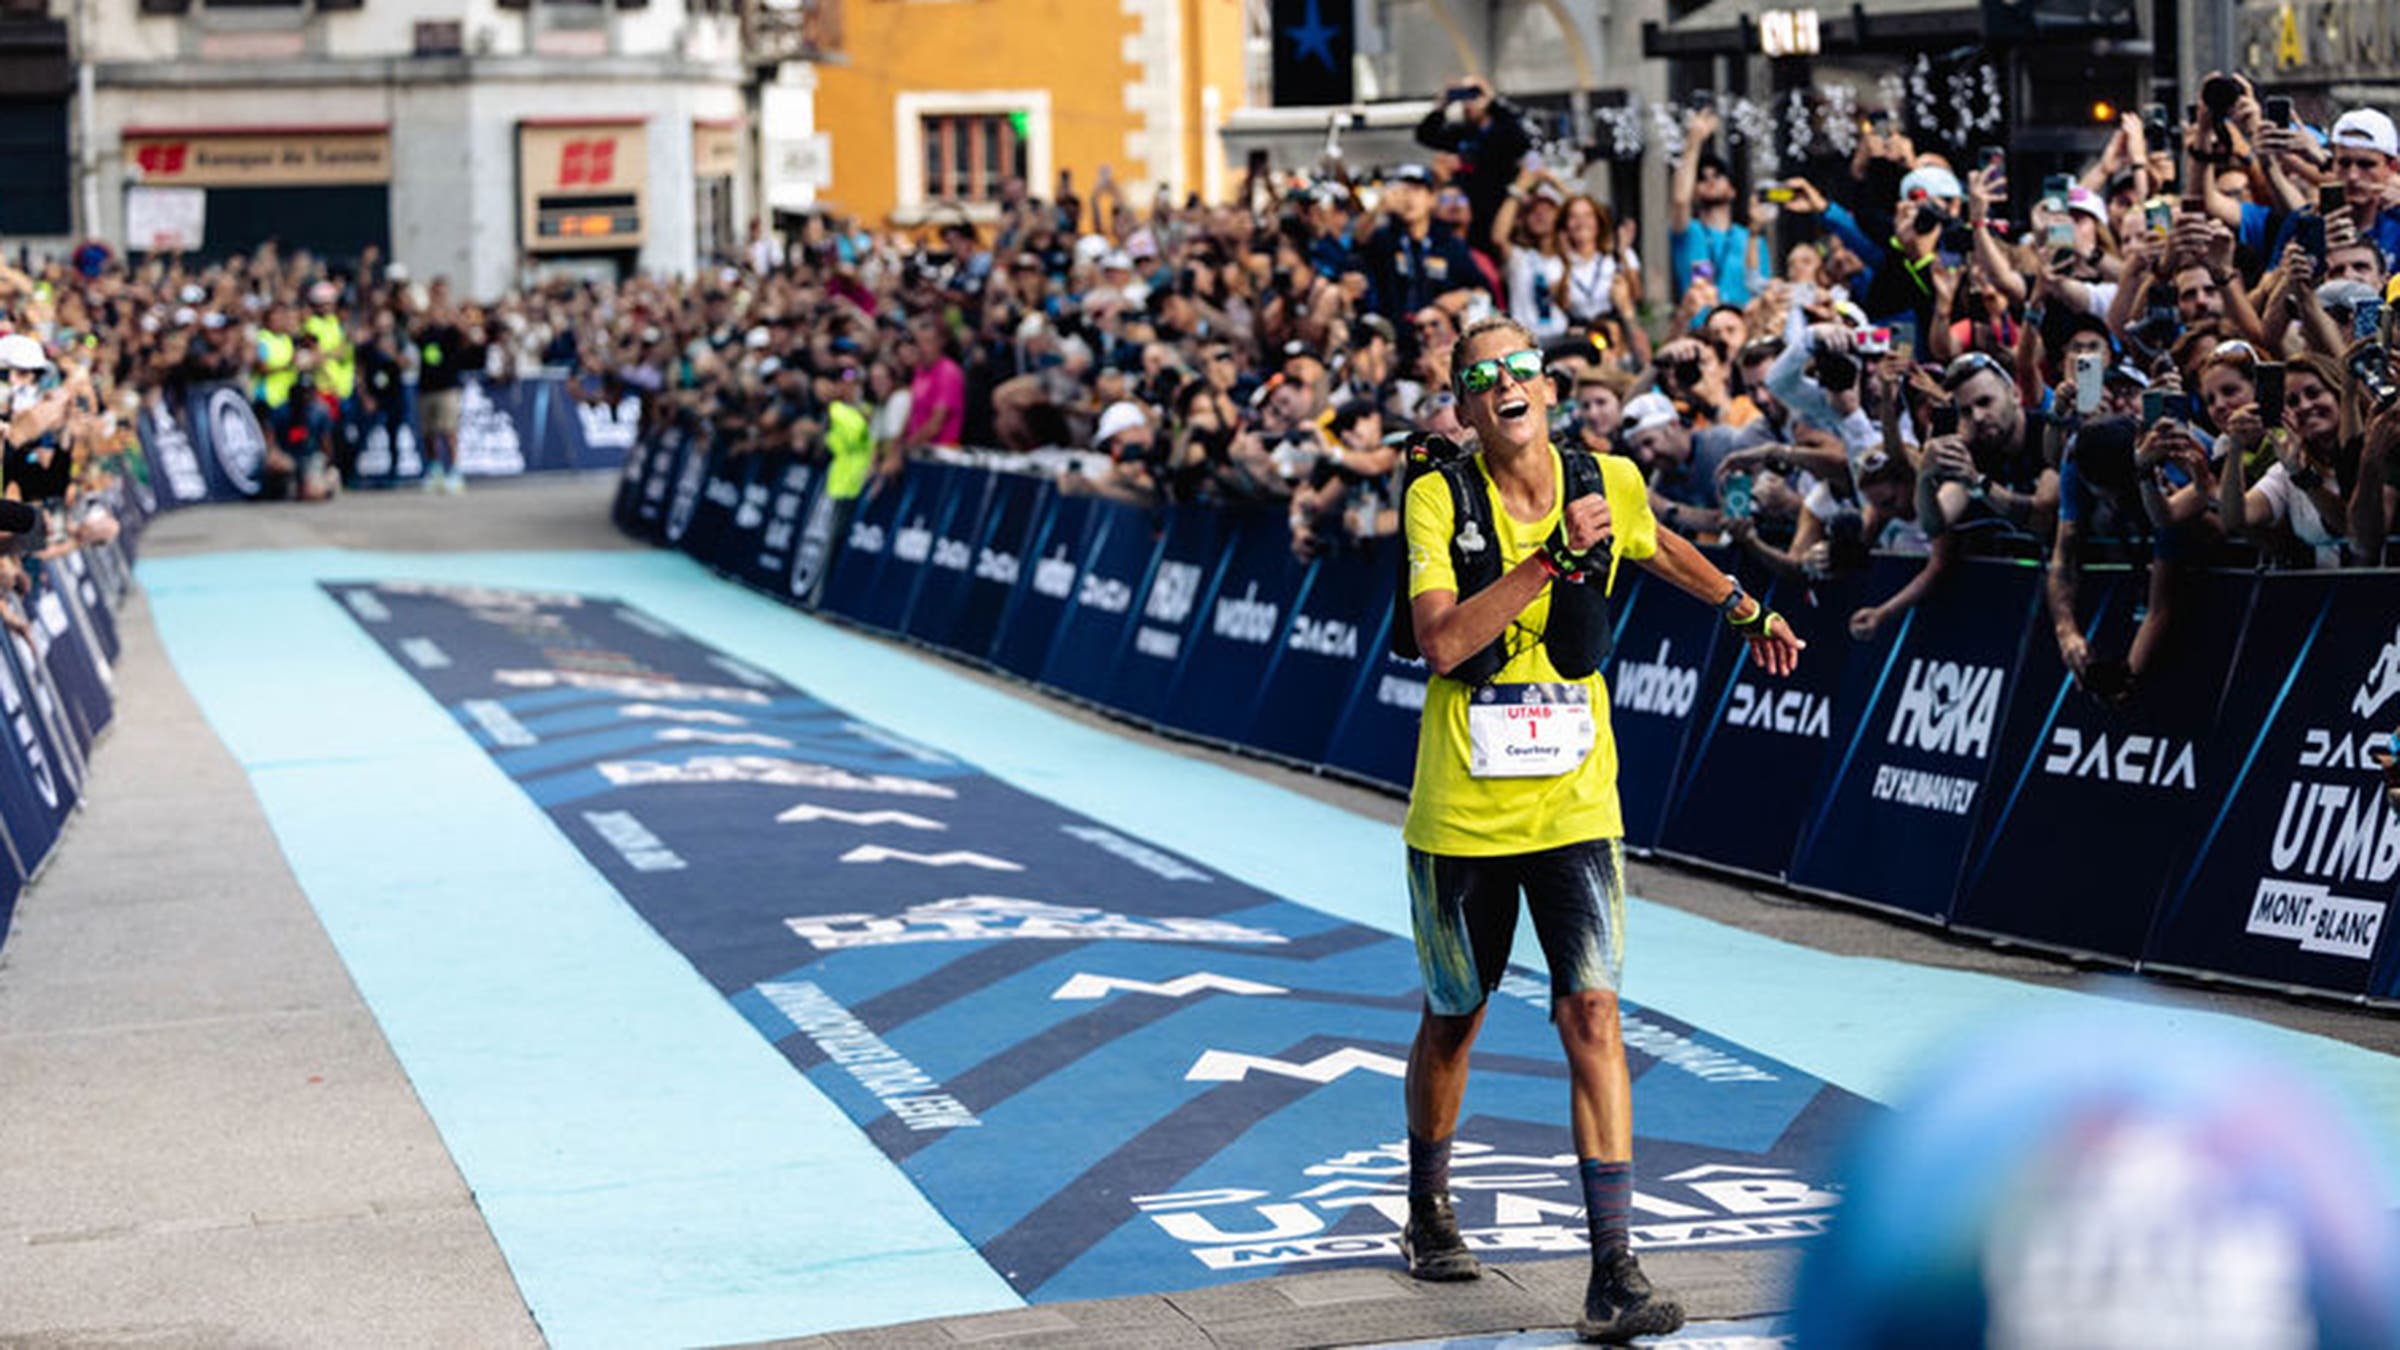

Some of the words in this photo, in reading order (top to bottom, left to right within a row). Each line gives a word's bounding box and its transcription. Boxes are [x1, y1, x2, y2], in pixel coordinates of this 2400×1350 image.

[1615, 638, 1698, 718] wahoo
[1507, 706, 1552, 719] UTMB
[1528, 720, 1537, 739] 1
[1727, 683, 1830, 738] DACIA
[1886, 658, 2004, 759] HOKA
[1505, 744, 1560, 757] Courtney
[2046, 727, 2196, 789] DACIA
[2299, 729, 2393, 770] DAC
